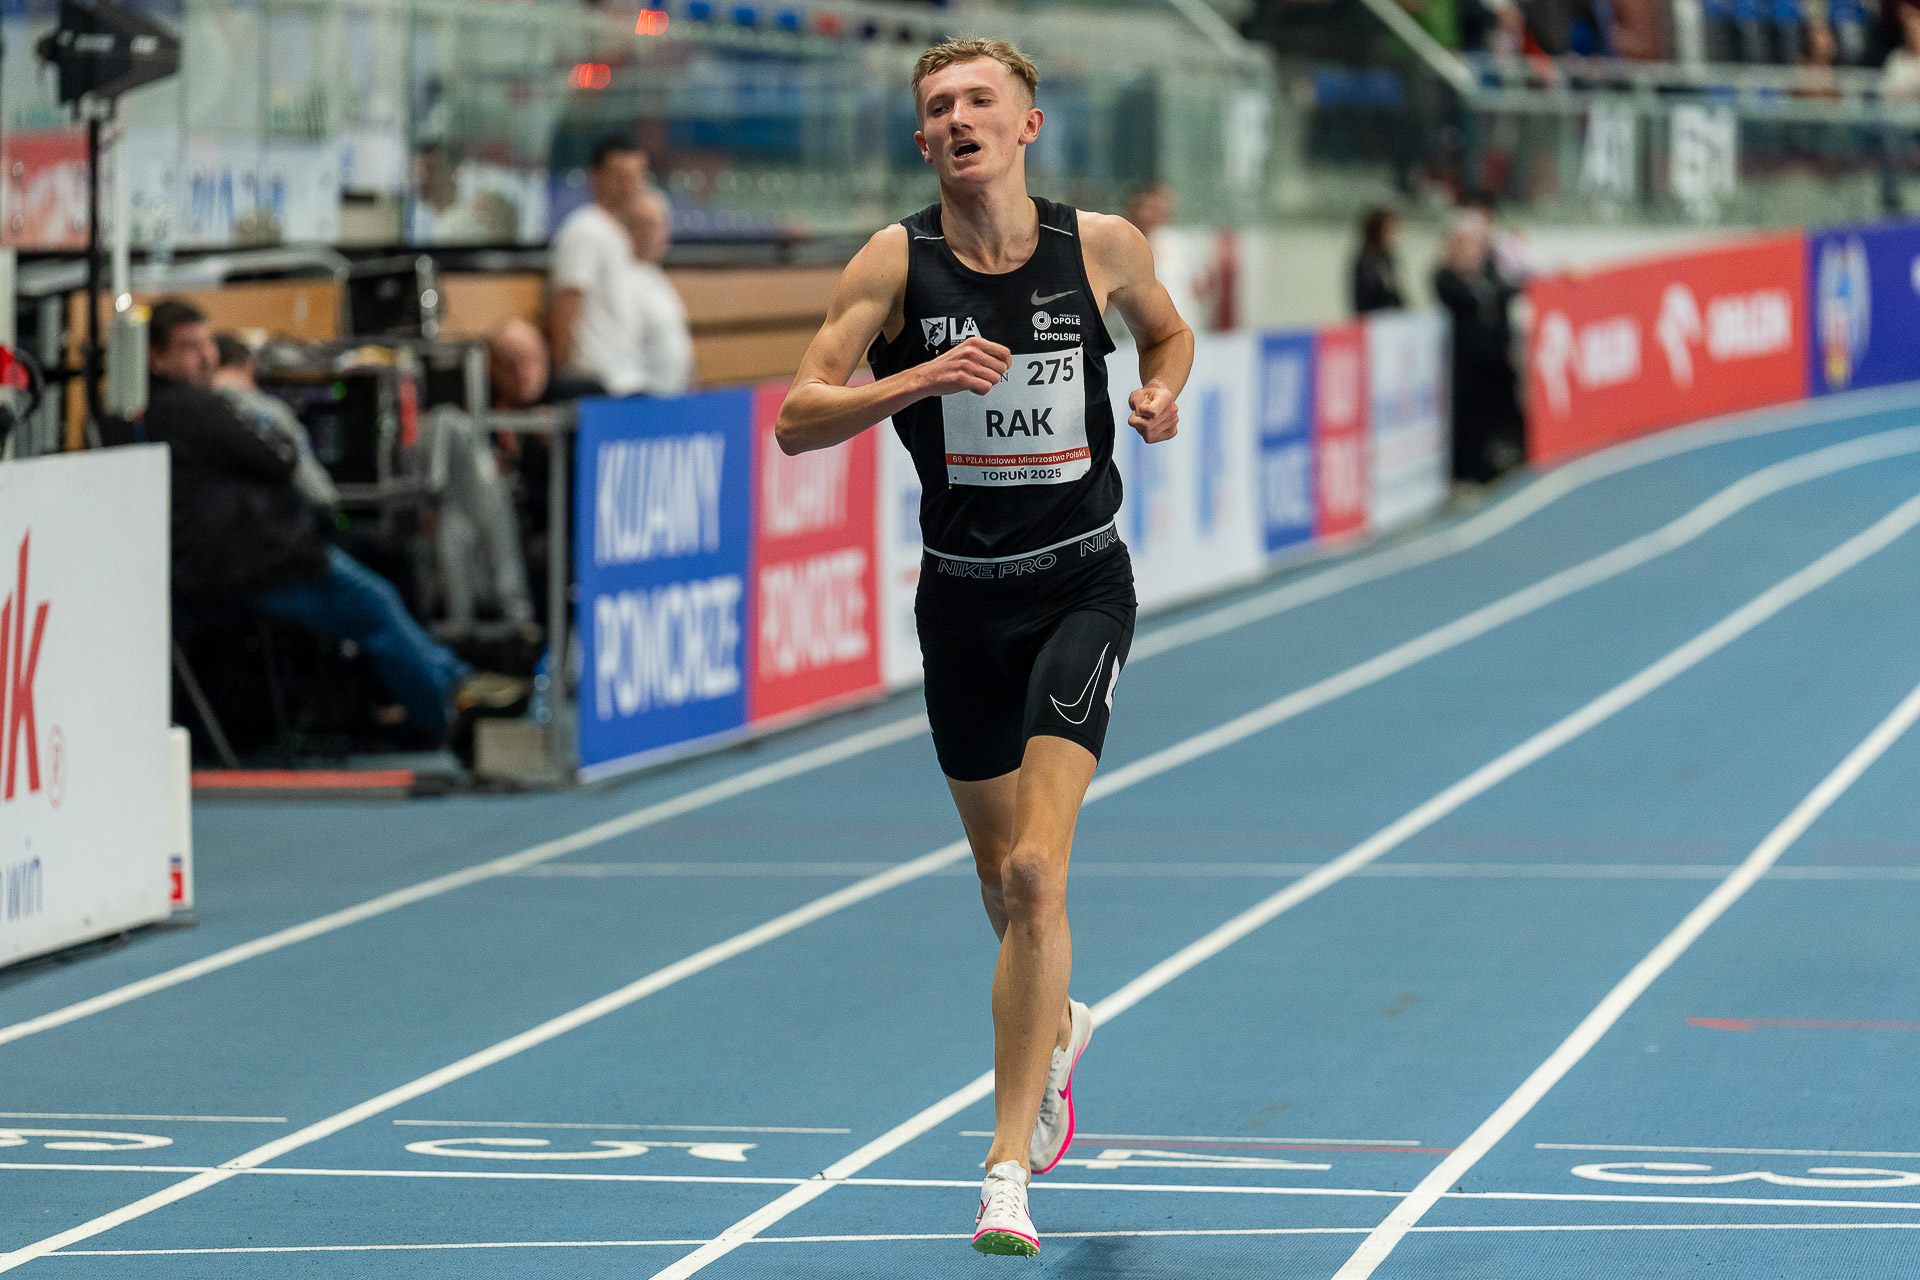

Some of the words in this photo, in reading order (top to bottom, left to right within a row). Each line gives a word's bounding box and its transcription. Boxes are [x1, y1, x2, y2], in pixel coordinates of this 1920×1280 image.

[950, 317, 982, 340] LA
[1052, 317, 1081, 326] OPOLE
[1039, 332, 1081, 342] OPOLSKIE
[1026, 356, 1074, 386] 275
[985, 407, 1054, 438] RAK
[952, 455, 965, 463] 69.
[966, 457, 984, 465] PZLA
[985, 457, 1016, 465] Halowe
[1066, 449, 1086, 459] Polski
[981, 467, 1027, 481] TORUŃ
[1031, 468, 1061, 479] 2025
[938, 558, 995, 579] NIKE
[999, 553, 1057, 579] PRO
[404, 1138, 758, 1162] 5
[1570, 1162, 1920, 1188] 3
